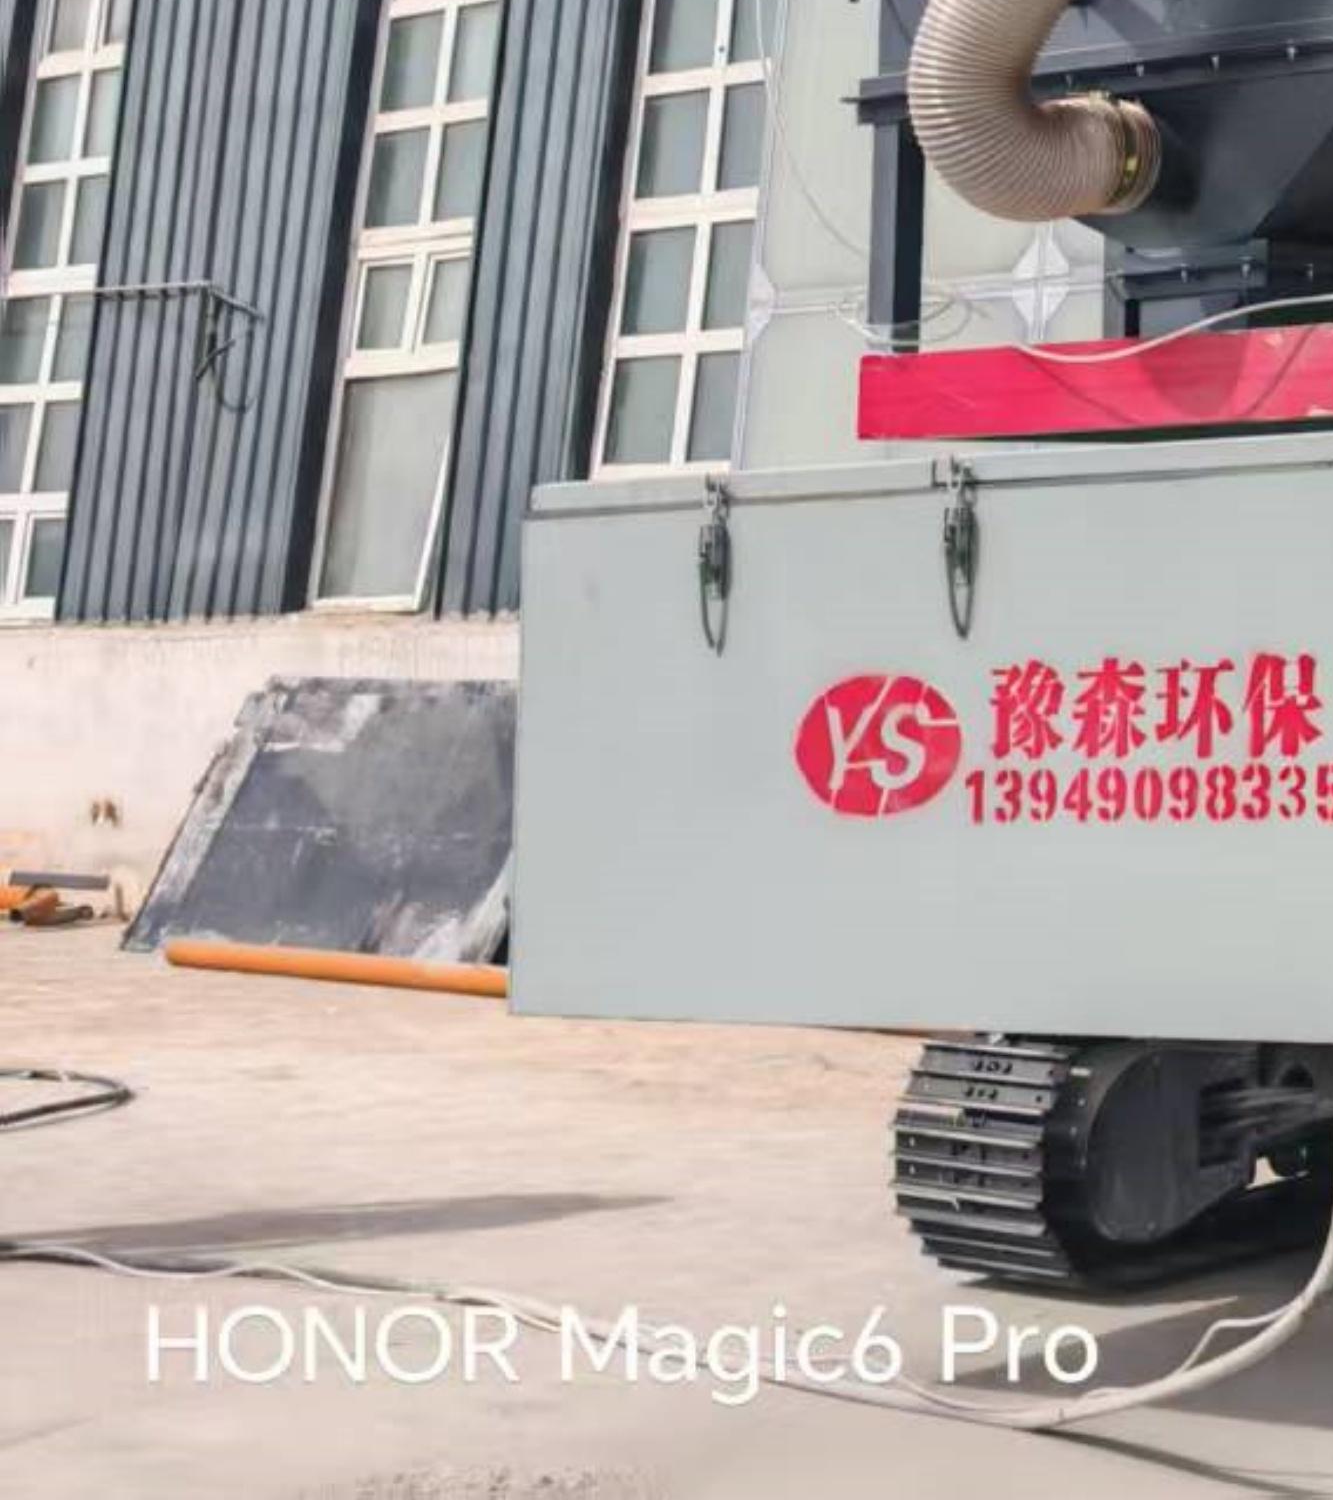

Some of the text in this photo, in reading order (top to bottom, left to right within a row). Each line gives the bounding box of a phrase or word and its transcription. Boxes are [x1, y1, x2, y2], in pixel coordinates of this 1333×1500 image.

[820, 690, 958, 802] YS
[990, 653, 1323, 760] 豫森环保
